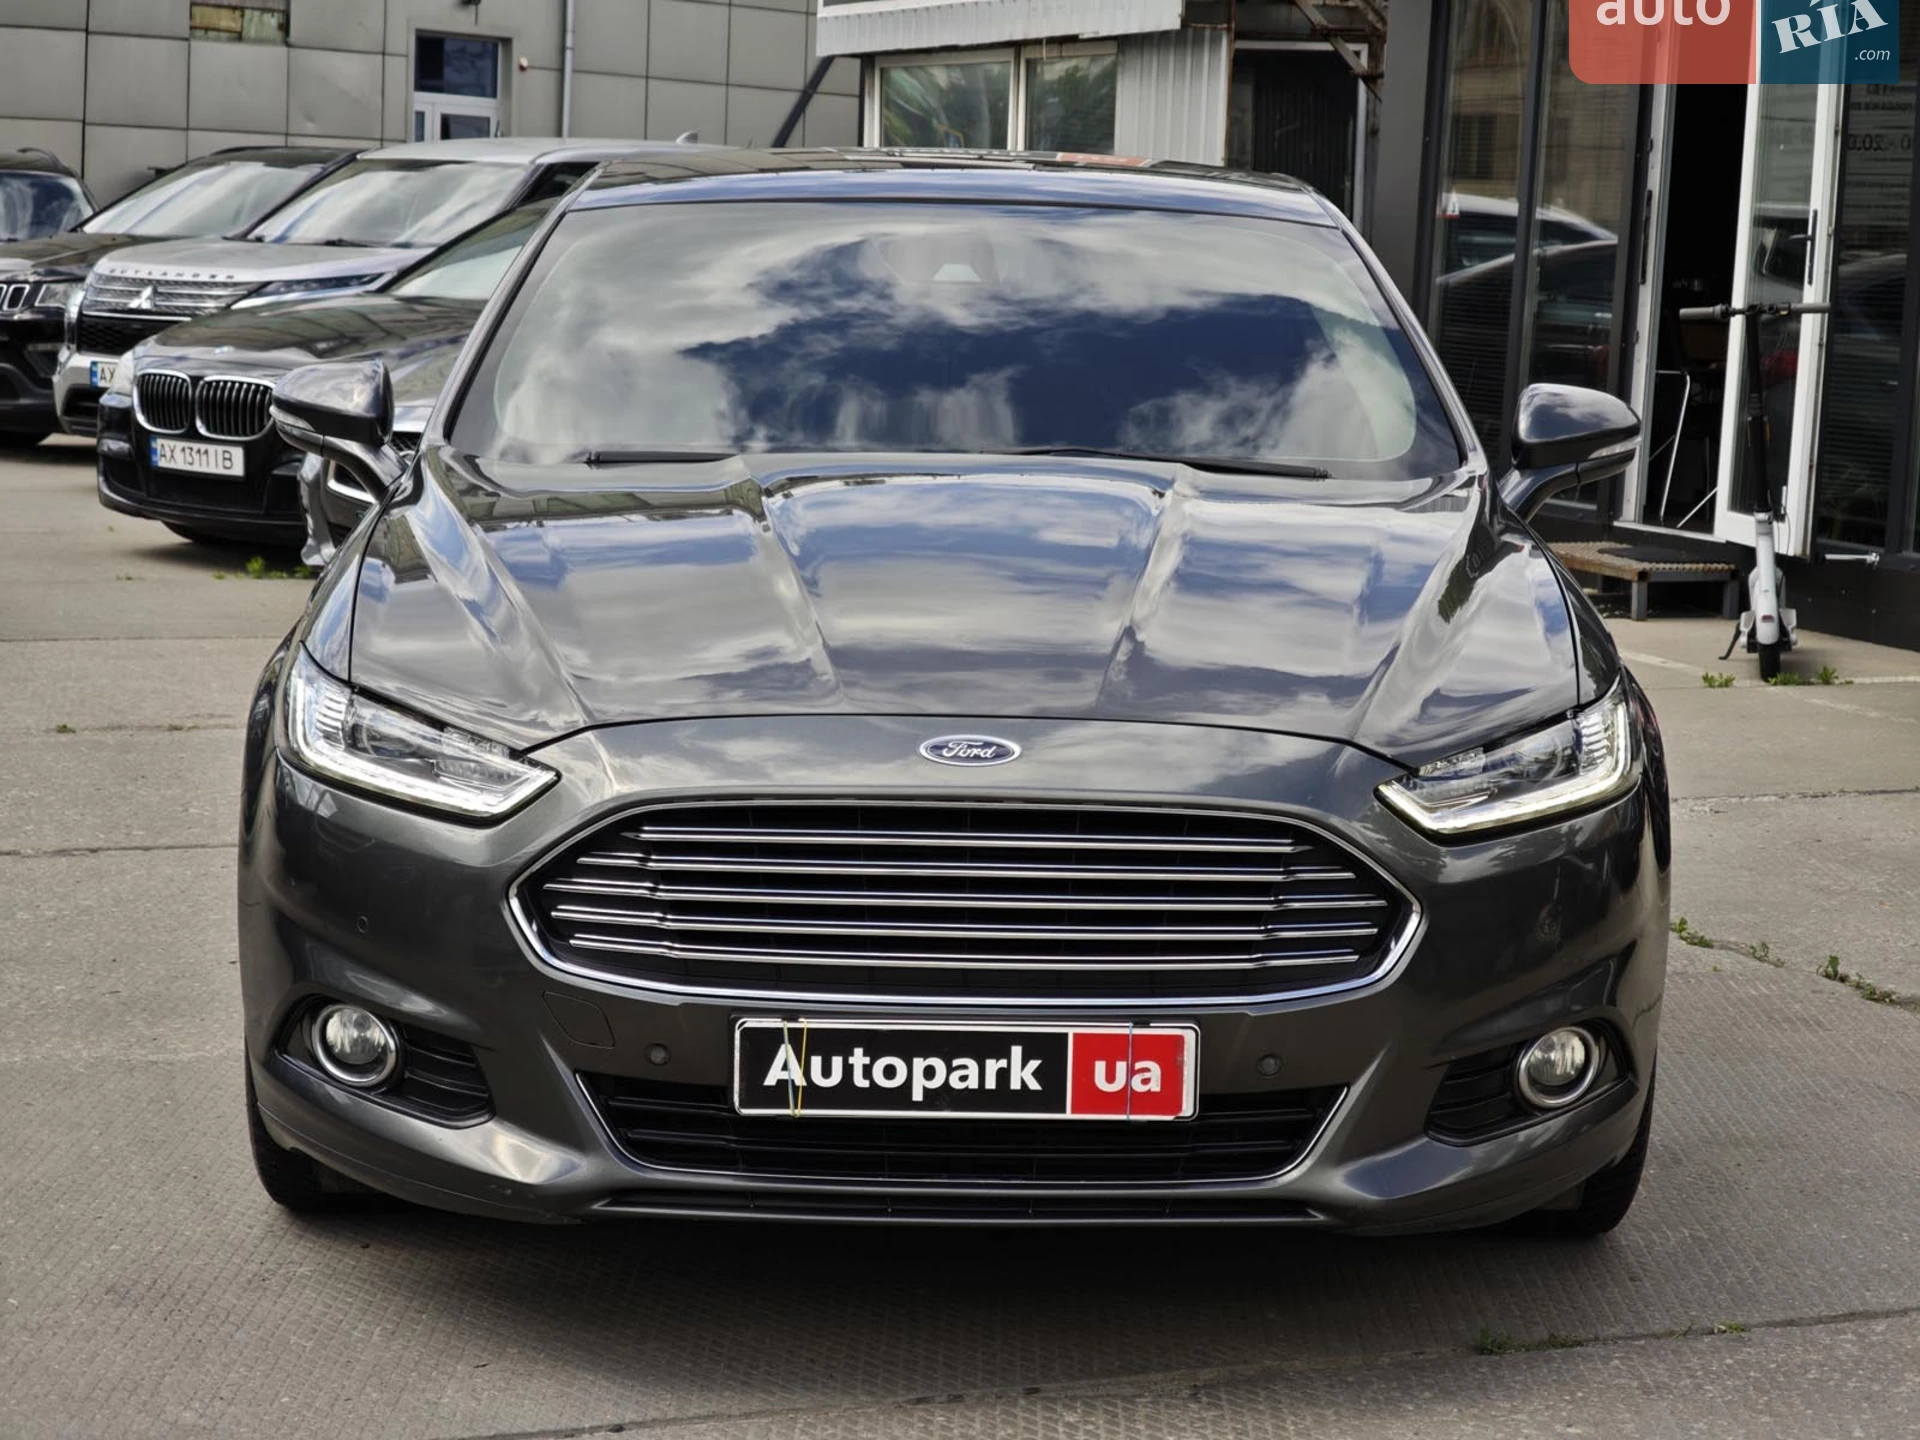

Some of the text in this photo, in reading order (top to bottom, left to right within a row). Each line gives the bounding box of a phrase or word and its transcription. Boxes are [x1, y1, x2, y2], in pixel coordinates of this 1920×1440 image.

[942, 741, 997, 758] Ford
[763, 1043, 1162, 1101] Autopark ua
